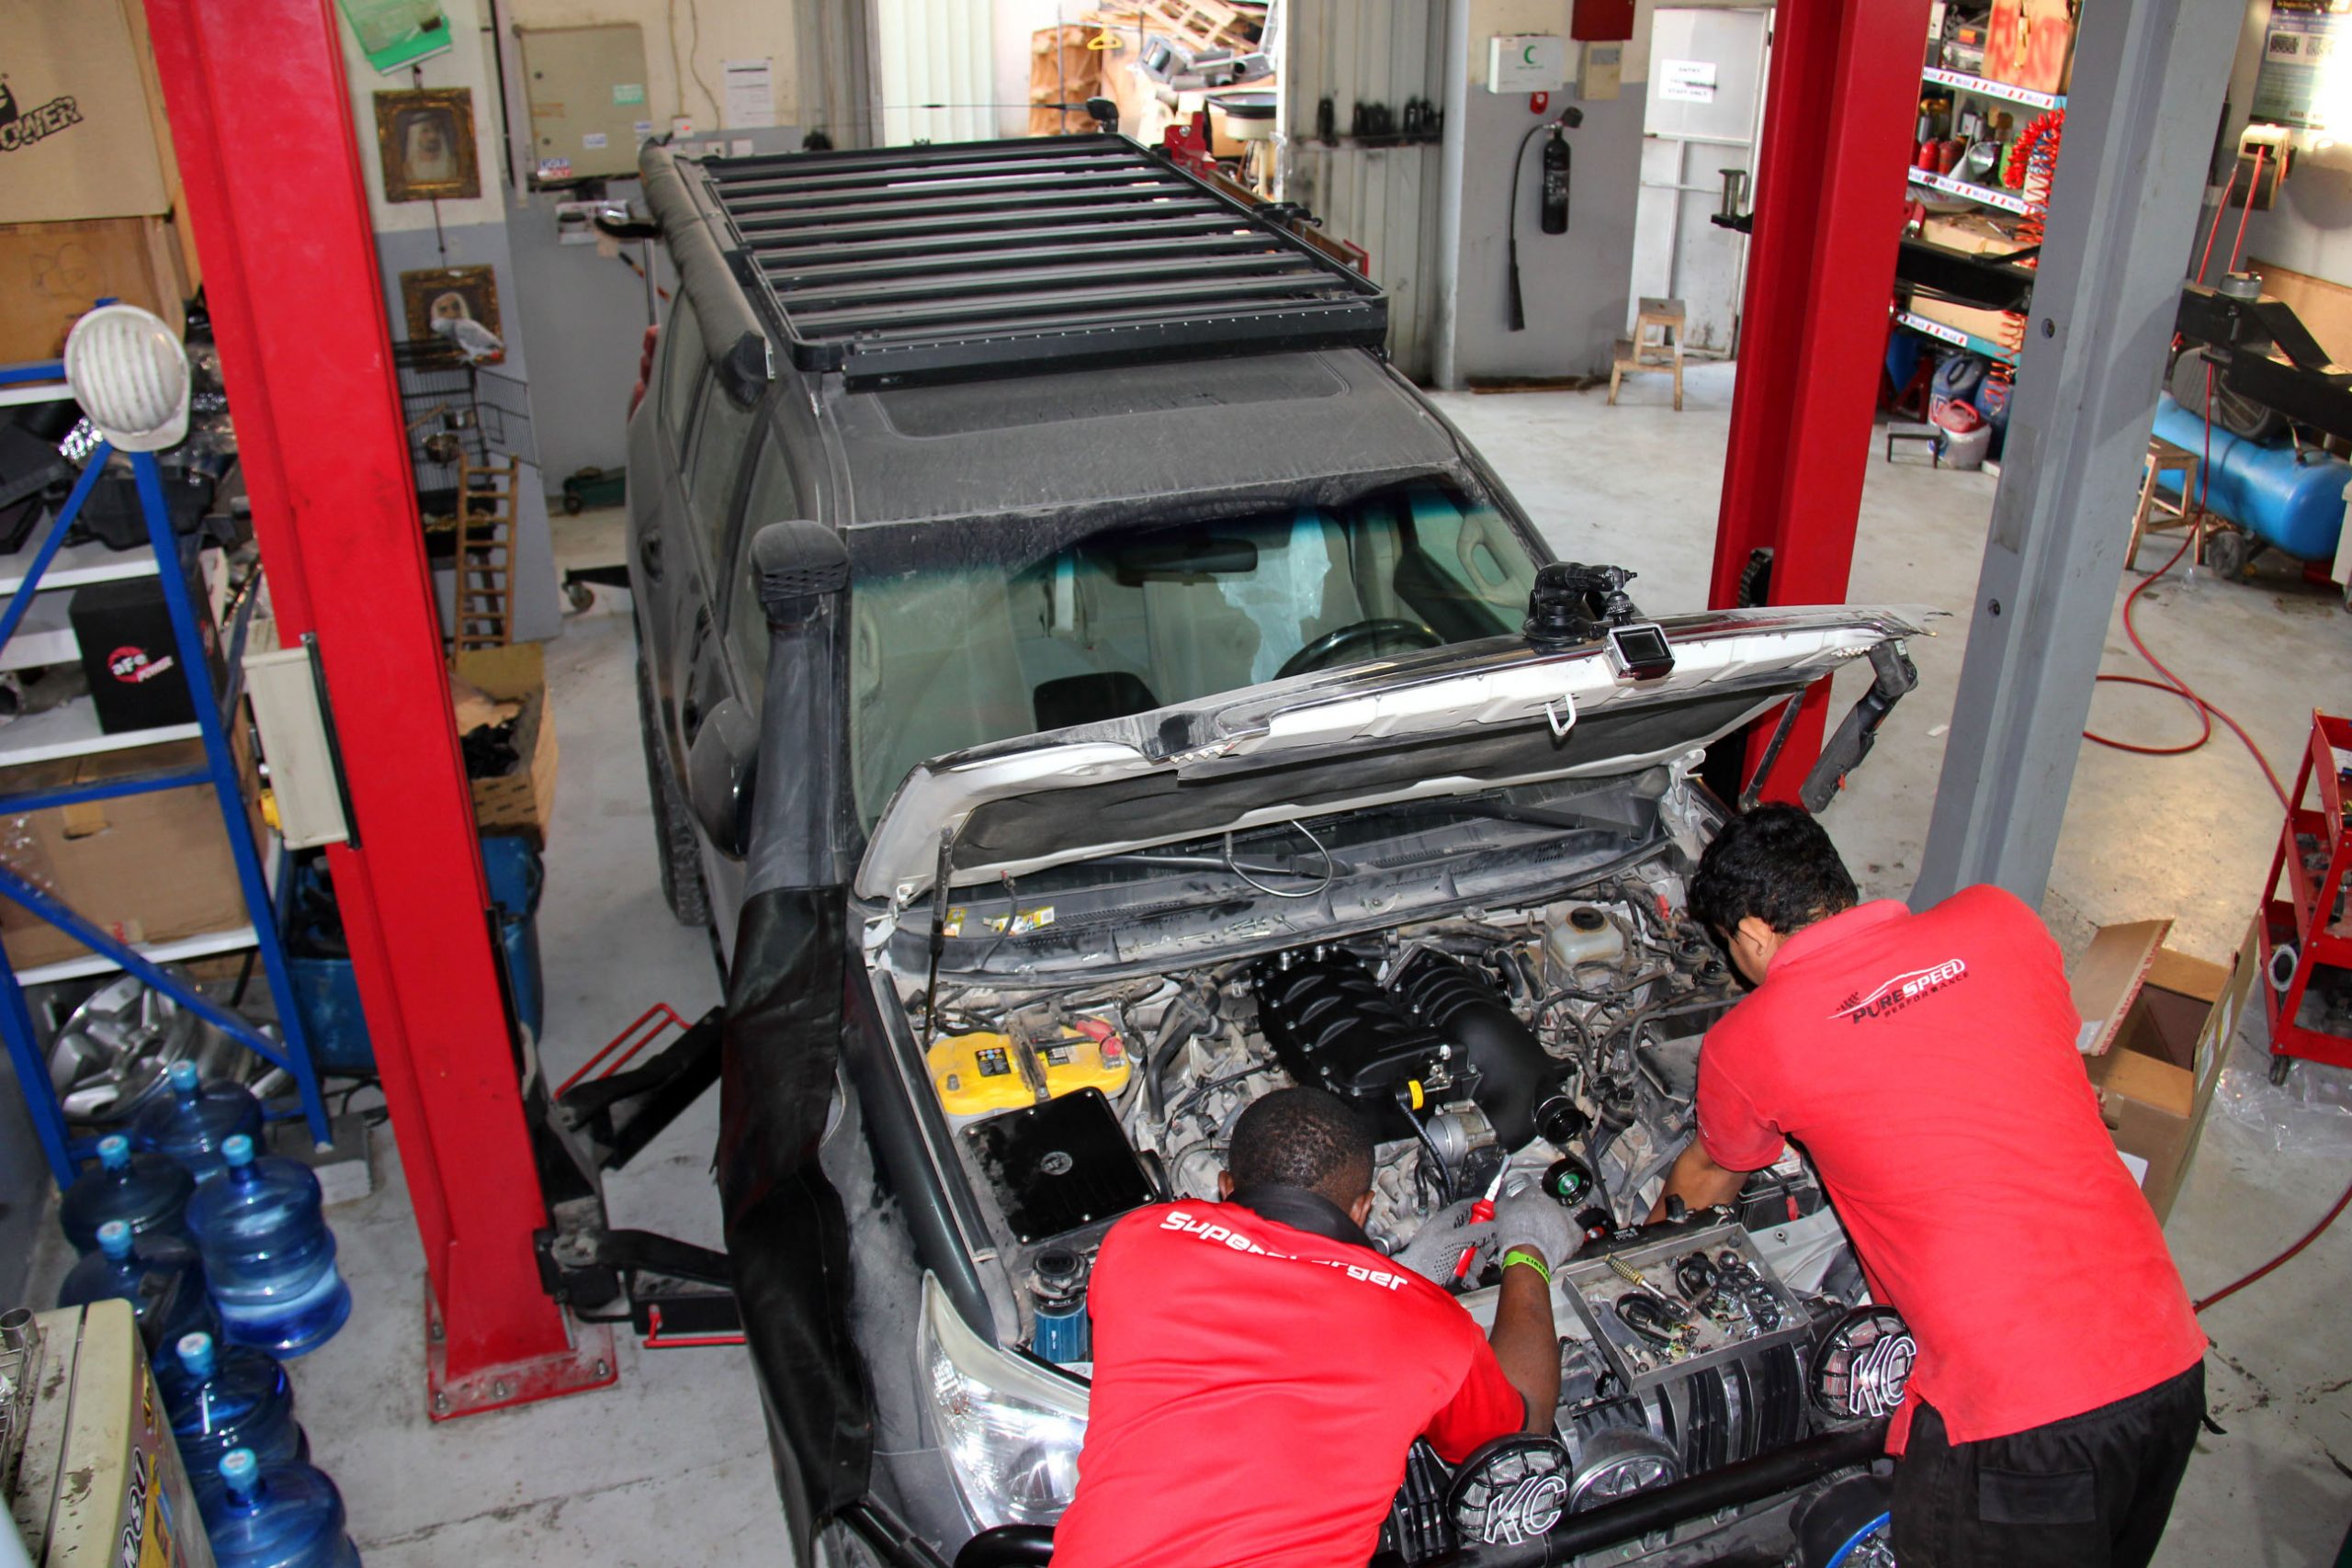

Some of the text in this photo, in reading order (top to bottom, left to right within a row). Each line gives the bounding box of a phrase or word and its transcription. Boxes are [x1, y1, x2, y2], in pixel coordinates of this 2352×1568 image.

[1884, 971, 1970, 1018] PERFORMANCE
[1849, 1334, 1917, 1417] KC
[1483, 1474, 1567, 1545] KC
